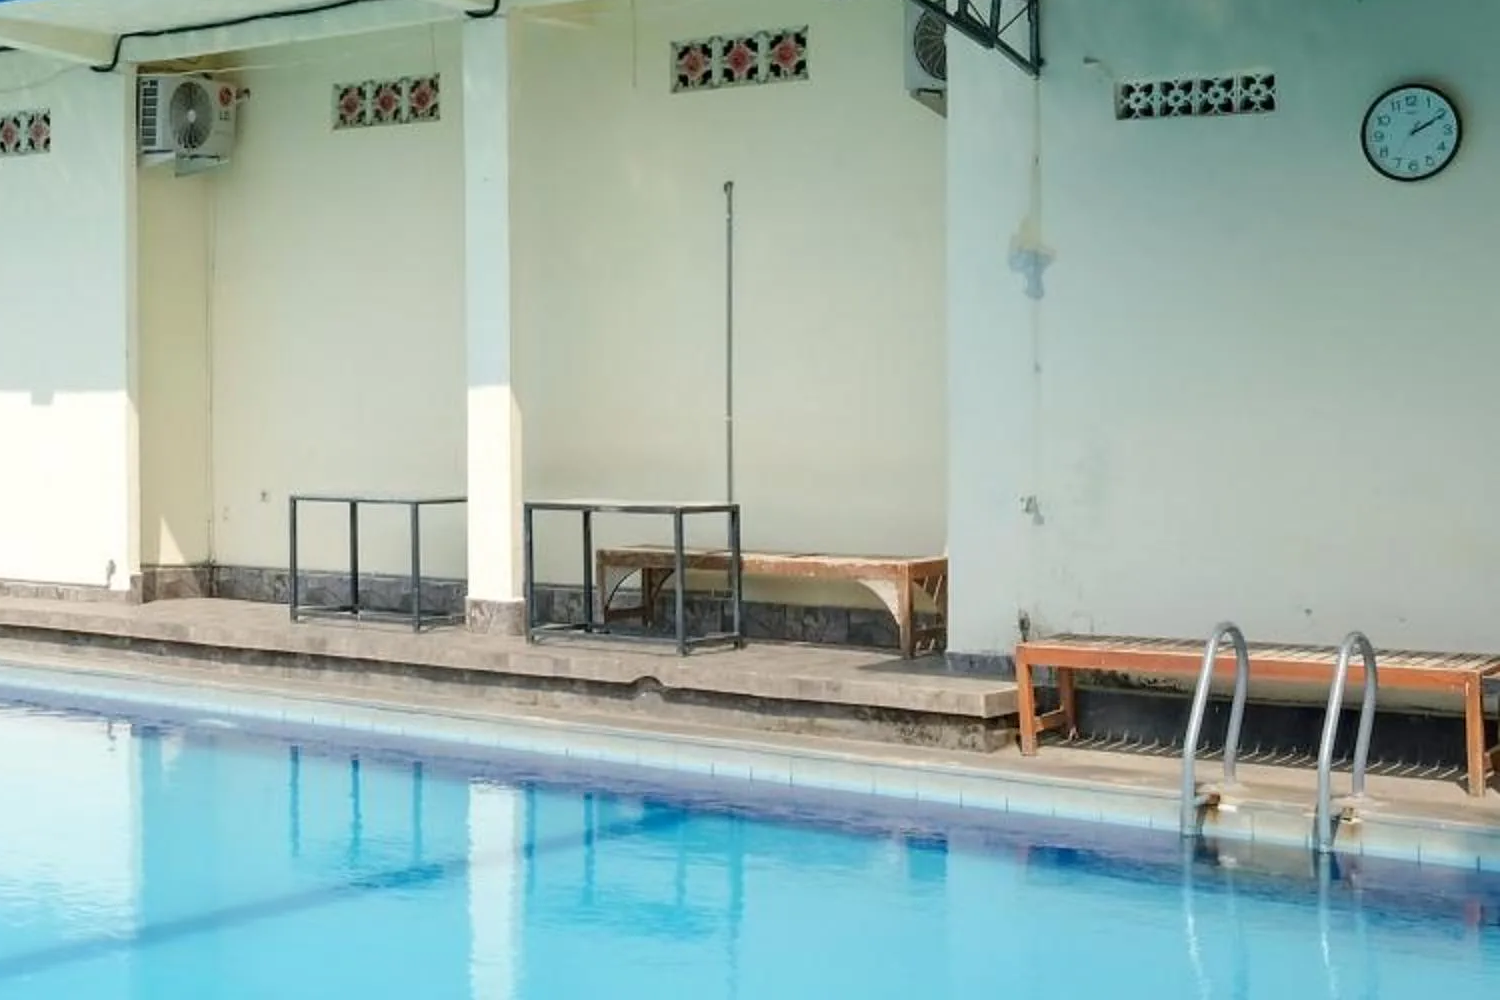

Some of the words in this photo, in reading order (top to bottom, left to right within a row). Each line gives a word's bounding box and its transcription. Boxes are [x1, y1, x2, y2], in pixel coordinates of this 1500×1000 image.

[1391, 100, 1401, 112] 11
[1405, 95, 1417, 106] 12
[1377, 114, 1391, 126] 10
[1444, 123, 1453, 136] 3
[1374, 131, 1384, 142] 9
[1436, 141, 1446, 153] 4
[1392, 157, 1403, 169] 7
[1408, 160, 1419, 172] 6
[1425, 155, 1434, 166] 5
